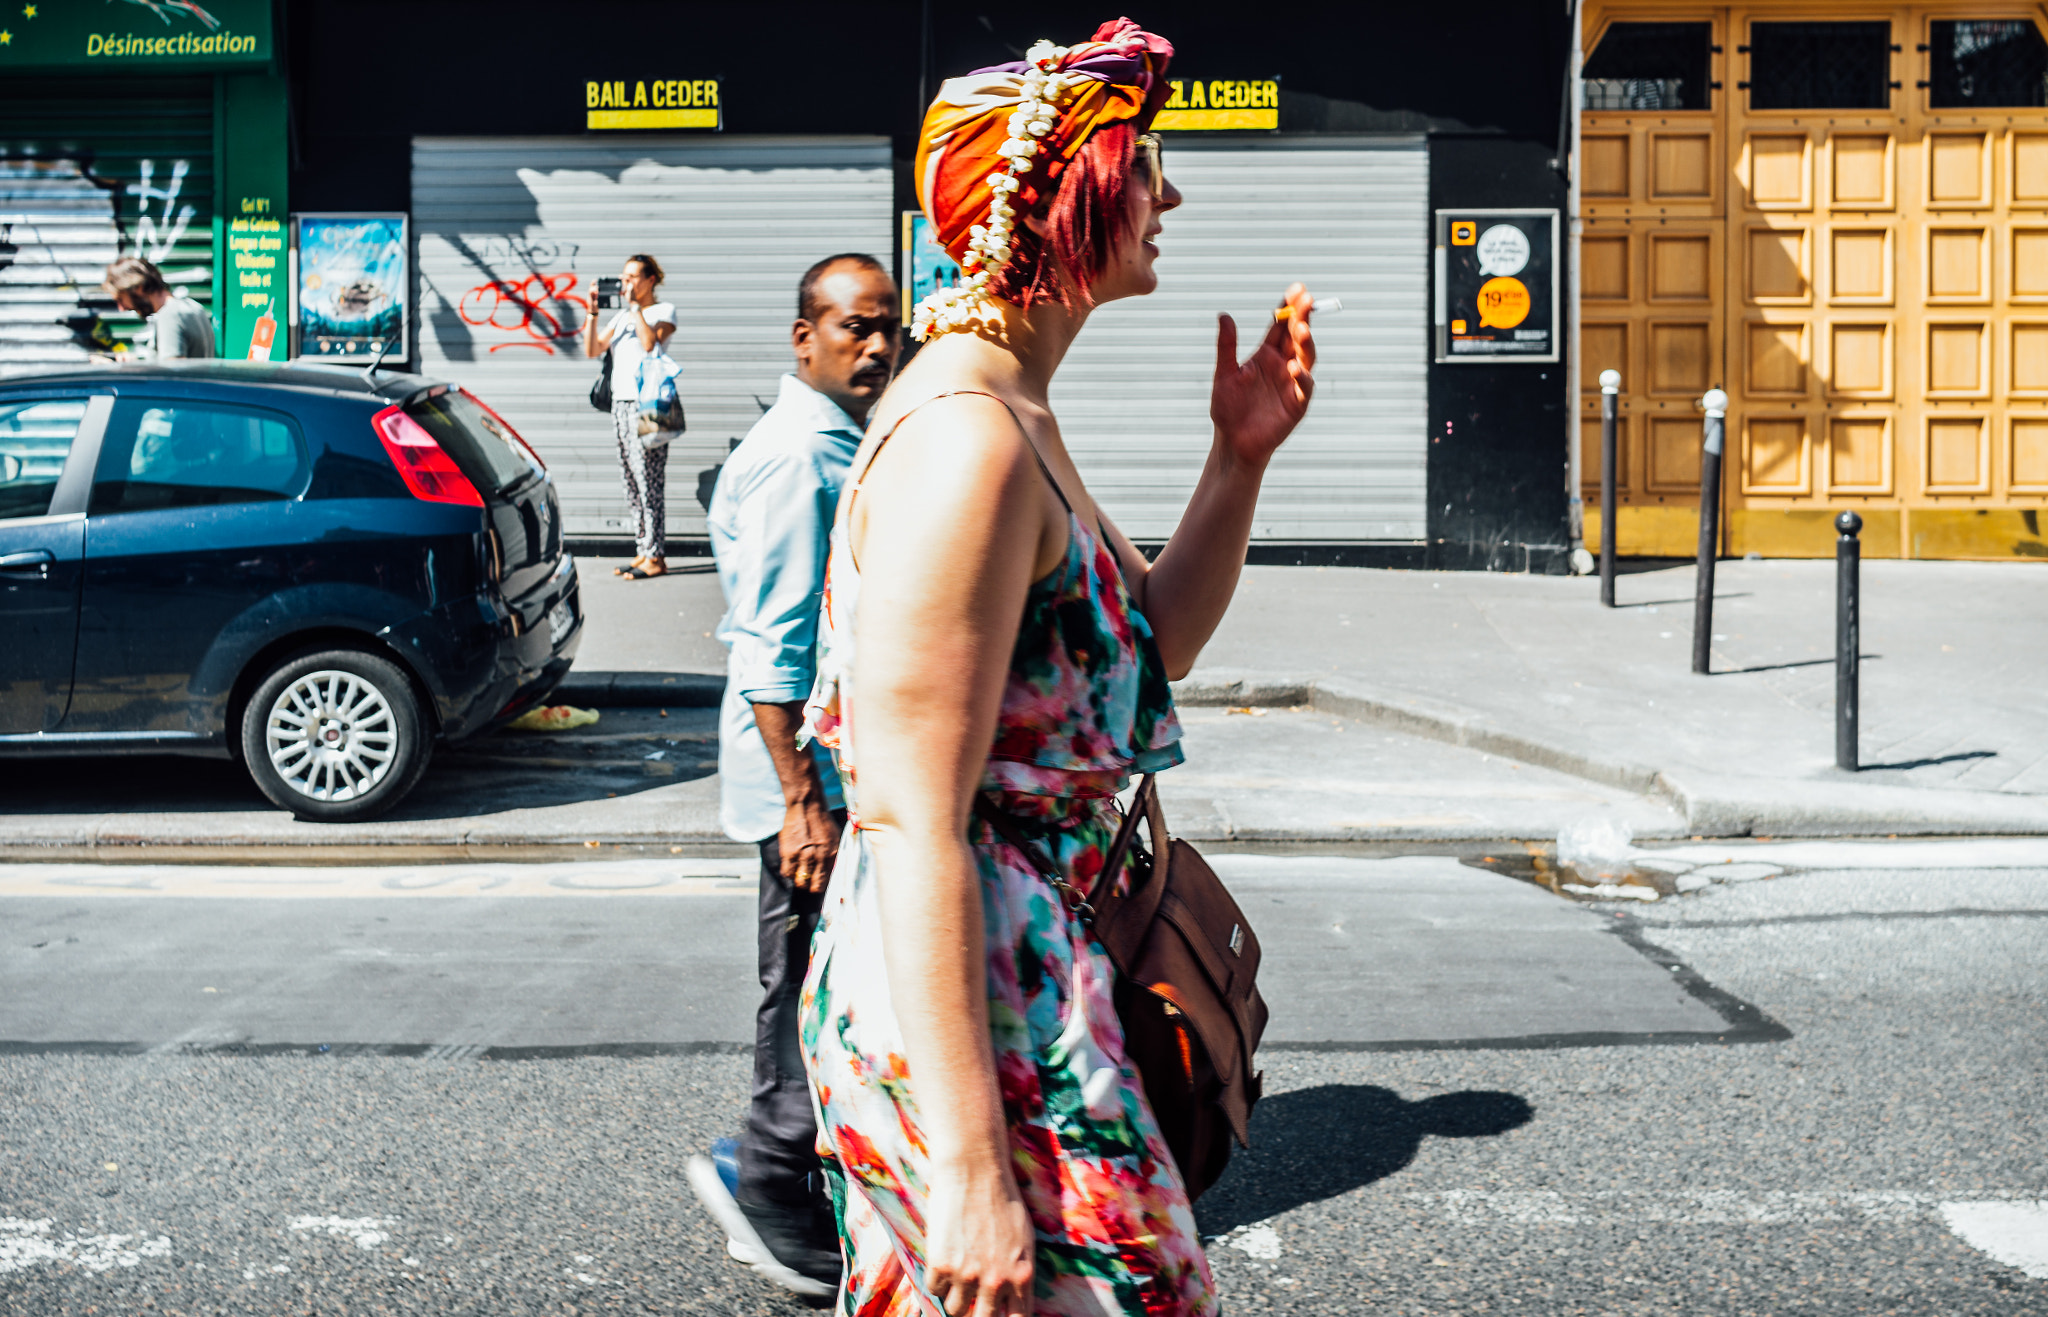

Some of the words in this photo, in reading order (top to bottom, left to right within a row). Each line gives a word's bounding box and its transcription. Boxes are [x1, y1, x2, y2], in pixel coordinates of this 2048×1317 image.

[86, 30, 257, 57] Désinsectisation
[586, 81, 631, 108] BAIL
[633, 80, 648, 108] A
[652, 80, 718, 107] CEDER
[1190, 80, 1206, 108] A
[1209, 80, 1278, 108] CEDER
[229, 234, 258, 253] Longue
[235, 252, 275, 269] Utilisation
[262, 273, 271, 287] et
[241, 292, 268, 308] propre
